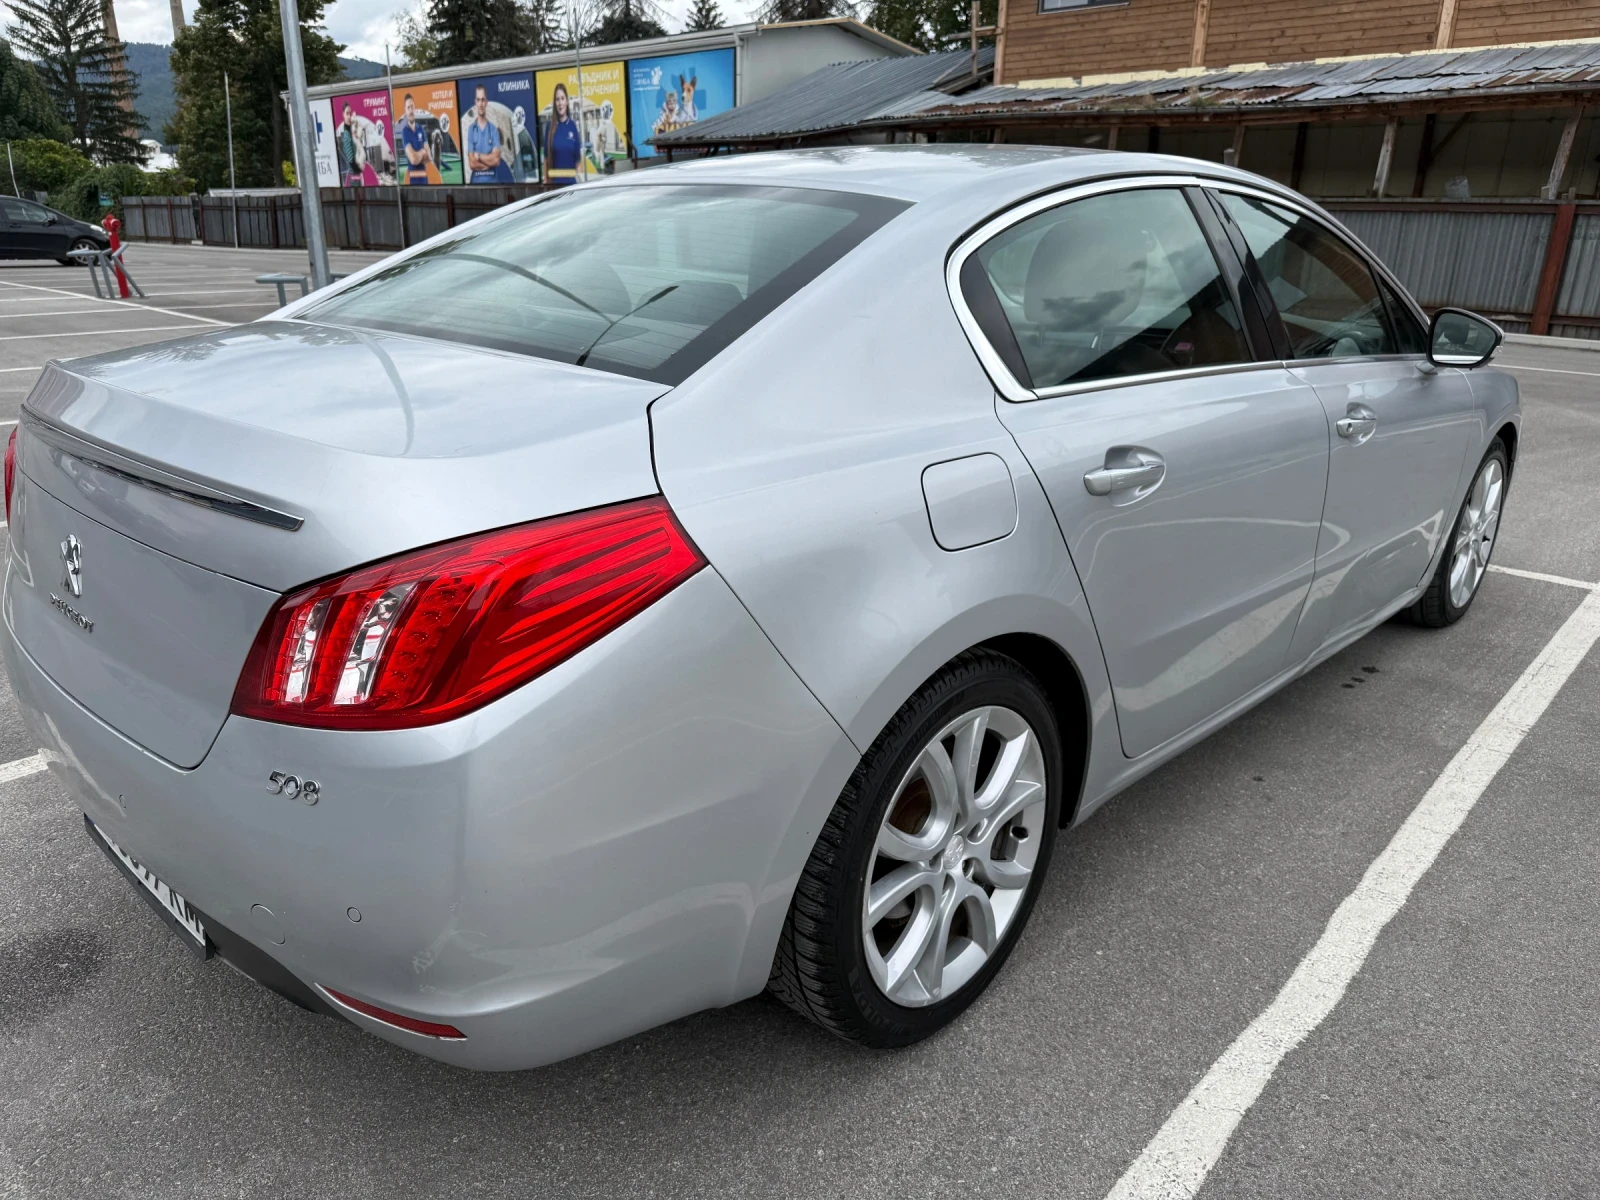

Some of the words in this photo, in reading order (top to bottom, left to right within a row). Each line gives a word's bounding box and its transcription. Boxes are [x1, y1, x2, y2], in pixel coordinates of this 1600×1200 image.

[498, 79, 530, 93] КЛИНИКА
[364, 96, 387, 108] ГРУМИНГ
[428, 100, 454, 111] УЧИЛИЩЕ
[378, 108, 388, 117] СПА
[49, 592, 95, 634] PEUGEOT
[266, 769, 321, 806] 508
